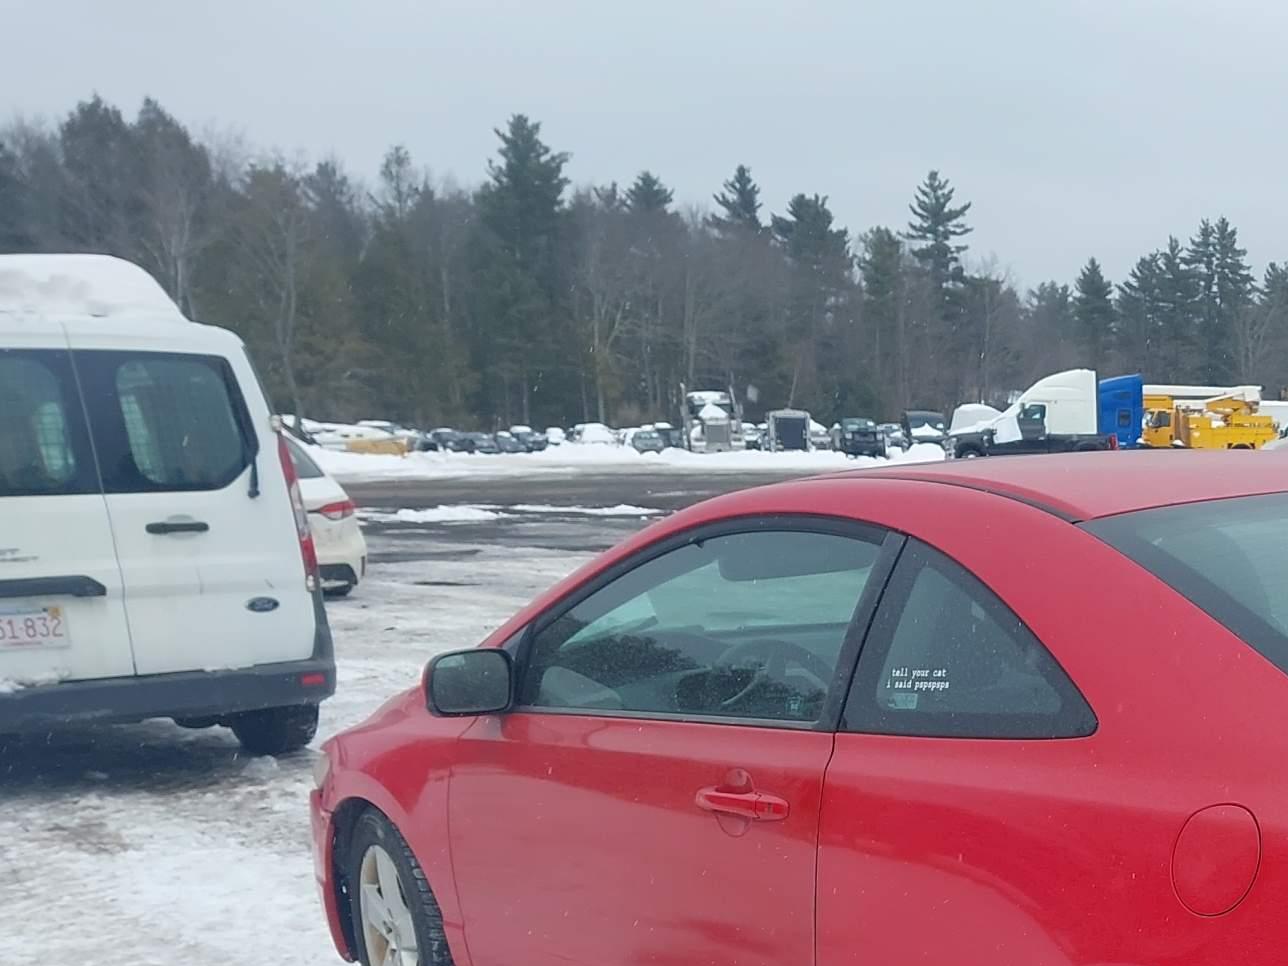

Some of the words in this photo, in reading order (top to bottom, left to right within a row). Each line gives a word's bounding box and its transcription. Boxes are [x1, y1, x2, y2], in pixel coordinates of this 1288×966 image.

[892, 667, 908, 677] tell
[912, 669, 930, 679] your
[933, 668, 947, 677] cat
[894, 679, 913, 689] said
[914, 681, 950, 691] pspspsps
